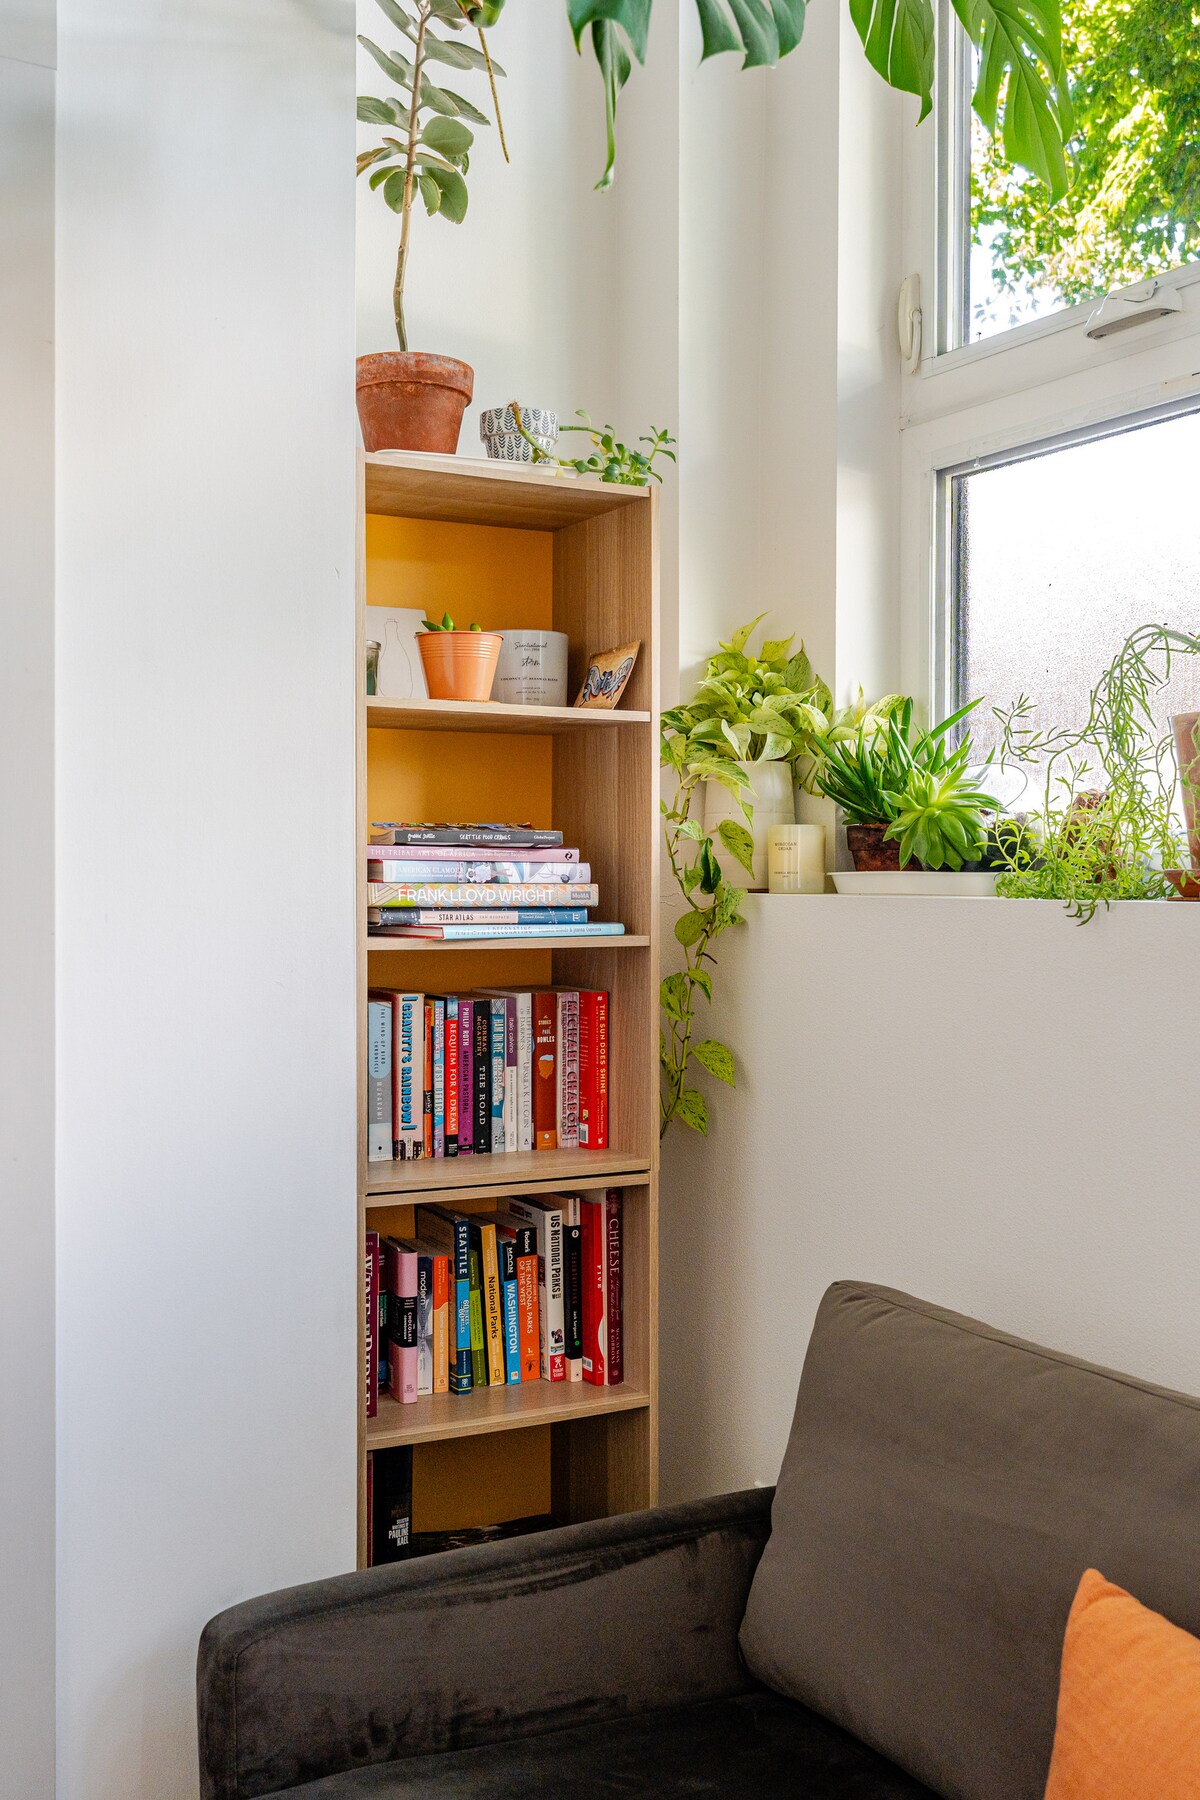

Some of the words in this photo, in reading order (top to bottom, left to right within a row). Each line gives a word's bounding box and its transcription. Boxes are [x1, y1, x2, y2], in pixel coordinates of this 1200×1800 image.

[398, 866, 431, 874] AMERICAN
[398, 889, 446, 902] FRANK
[450, 889, 496, 902] LLOYD
[498, 889, 555, 902] WRIGHT
[402, 1003, 412, 1062] GRAVITY'S
[494, 1019, 504, 1032] HAM
[567, 1001, 577, 1067] MICHAEL
[493, 1043, 504, 1053] RYE
[435, 1064, 444, 1083] POST
[402, 1066, 413, 1123] RAINBOW
[435, 1088, 444, 1114] OFFICE
[567, 1072, 577, 1135] CHABON
[550, 1215, 561, 1228] US
[459, 1226, 467, 1274] SEATTLE
[609, 1218, 619, 1276] CHEESE
[519, 1260, 525, 1270] OF
[463, 1300, 469, 1309] 60
[488, 1276, 498, 1314] National
[459, 1308, 464, 1318] 60
[507, 1283, 518, 1354] WASHINGTON
[490, 1316, 501, 1339] Parks
[388, 1528, 408, 1539] PAULINE
[397, 1536, 408, 1546] KAEL
